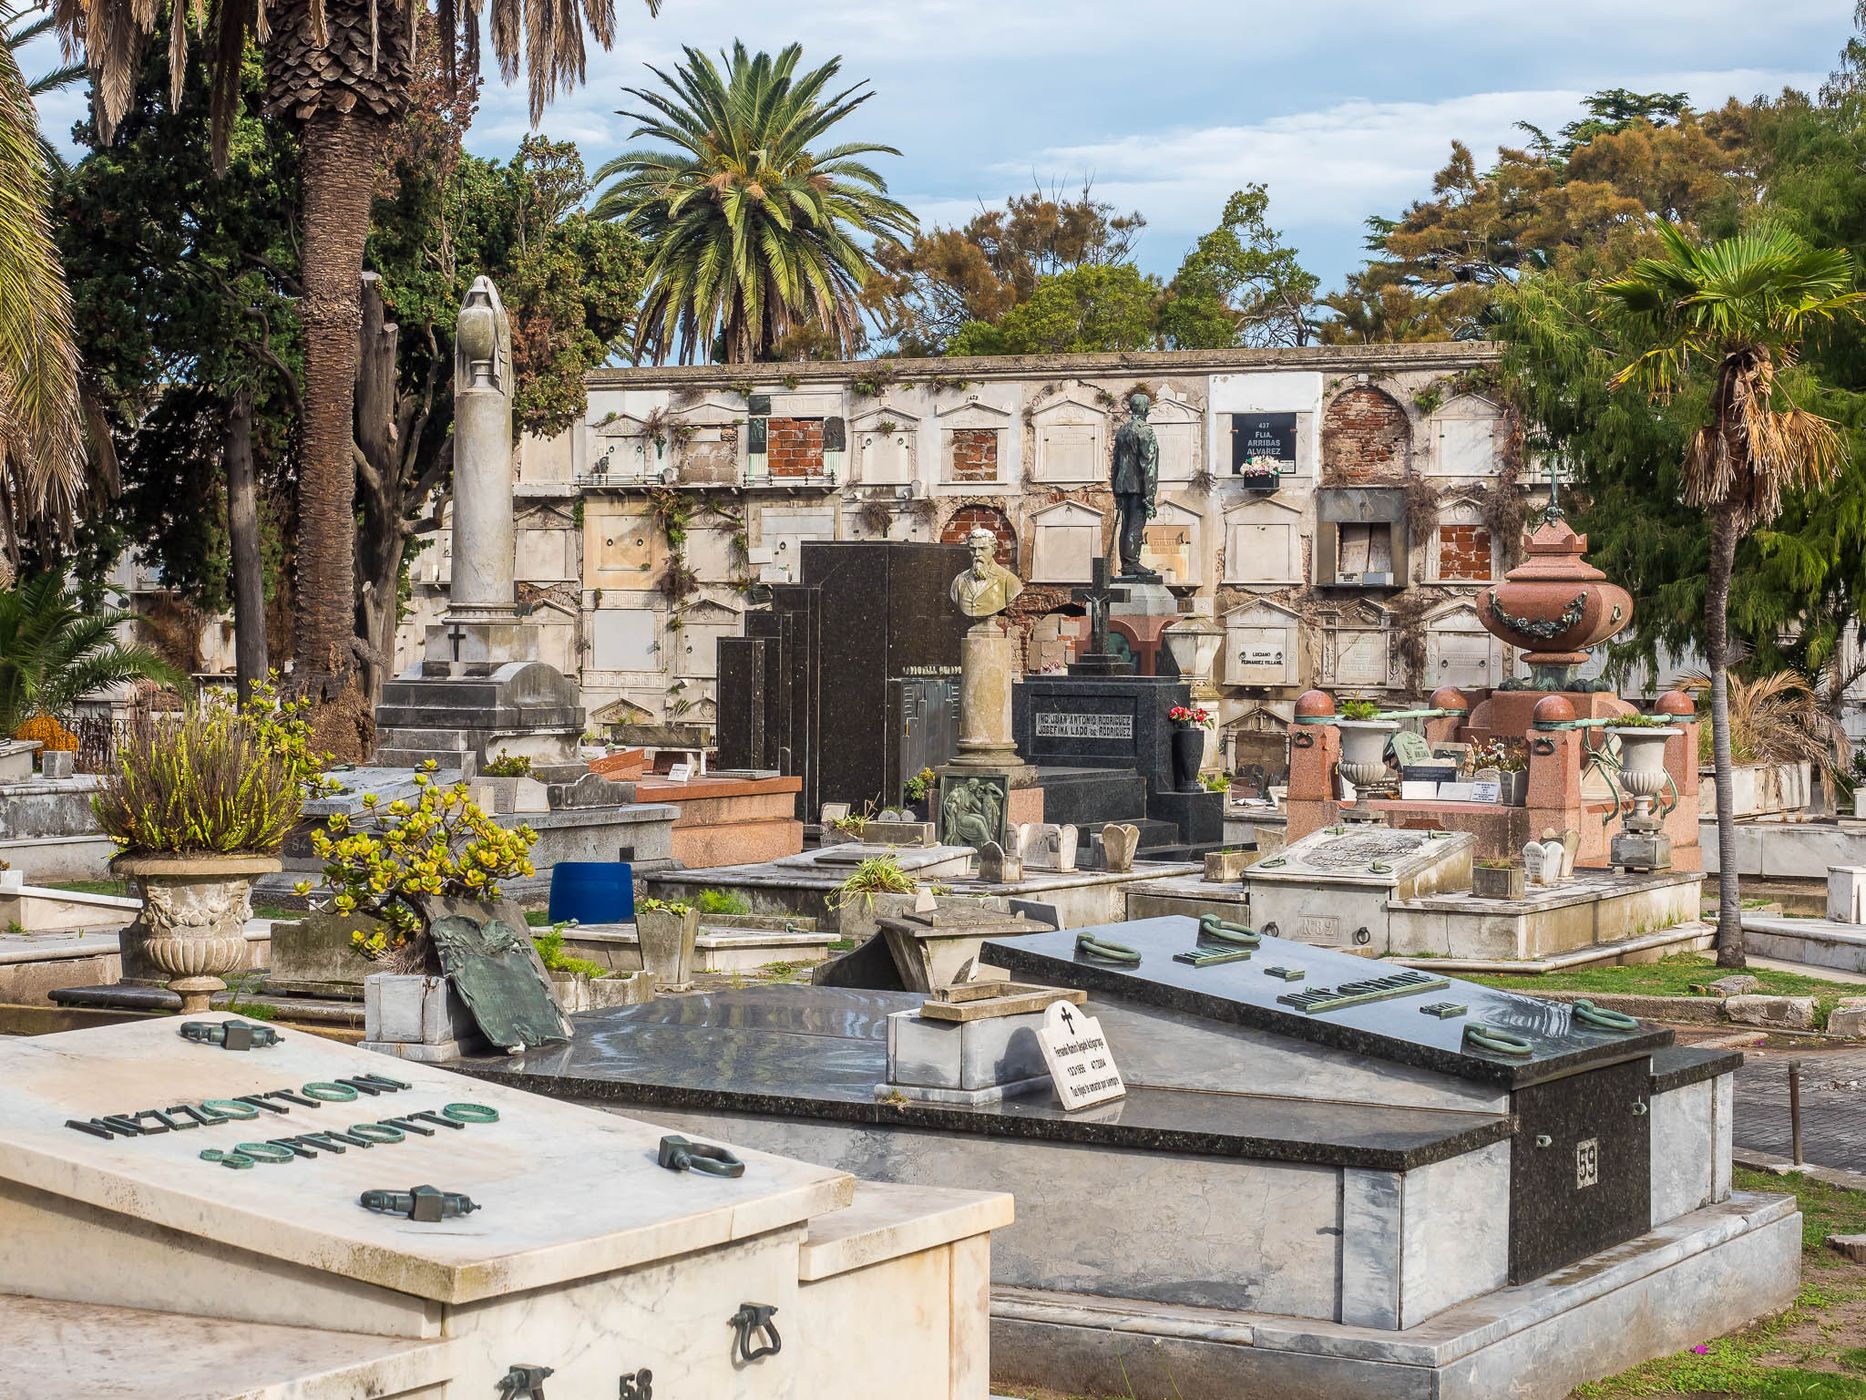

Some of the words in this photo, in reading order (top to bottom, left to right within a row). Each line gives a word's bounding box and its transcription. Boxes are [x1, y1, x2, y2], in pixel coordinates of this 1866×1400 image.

[1247, 439, 1281, 447] ARRIBAS
[1246, 447, 1281, 455] ALVAREZ
[1050, 714, 1068, 724] JUAN
[1069, 715, 1097, 725] ANTONIO
[1098, 716, 1131, 726] RODRIGUEZ
[1038, 725, 1069, 735] JOSEFINA
[1070, 726, 1088, 735] LADO
[1098, 726, 1131, 737] RODRIGUEZ
[1578, 1145, 1596, 1181] 59
